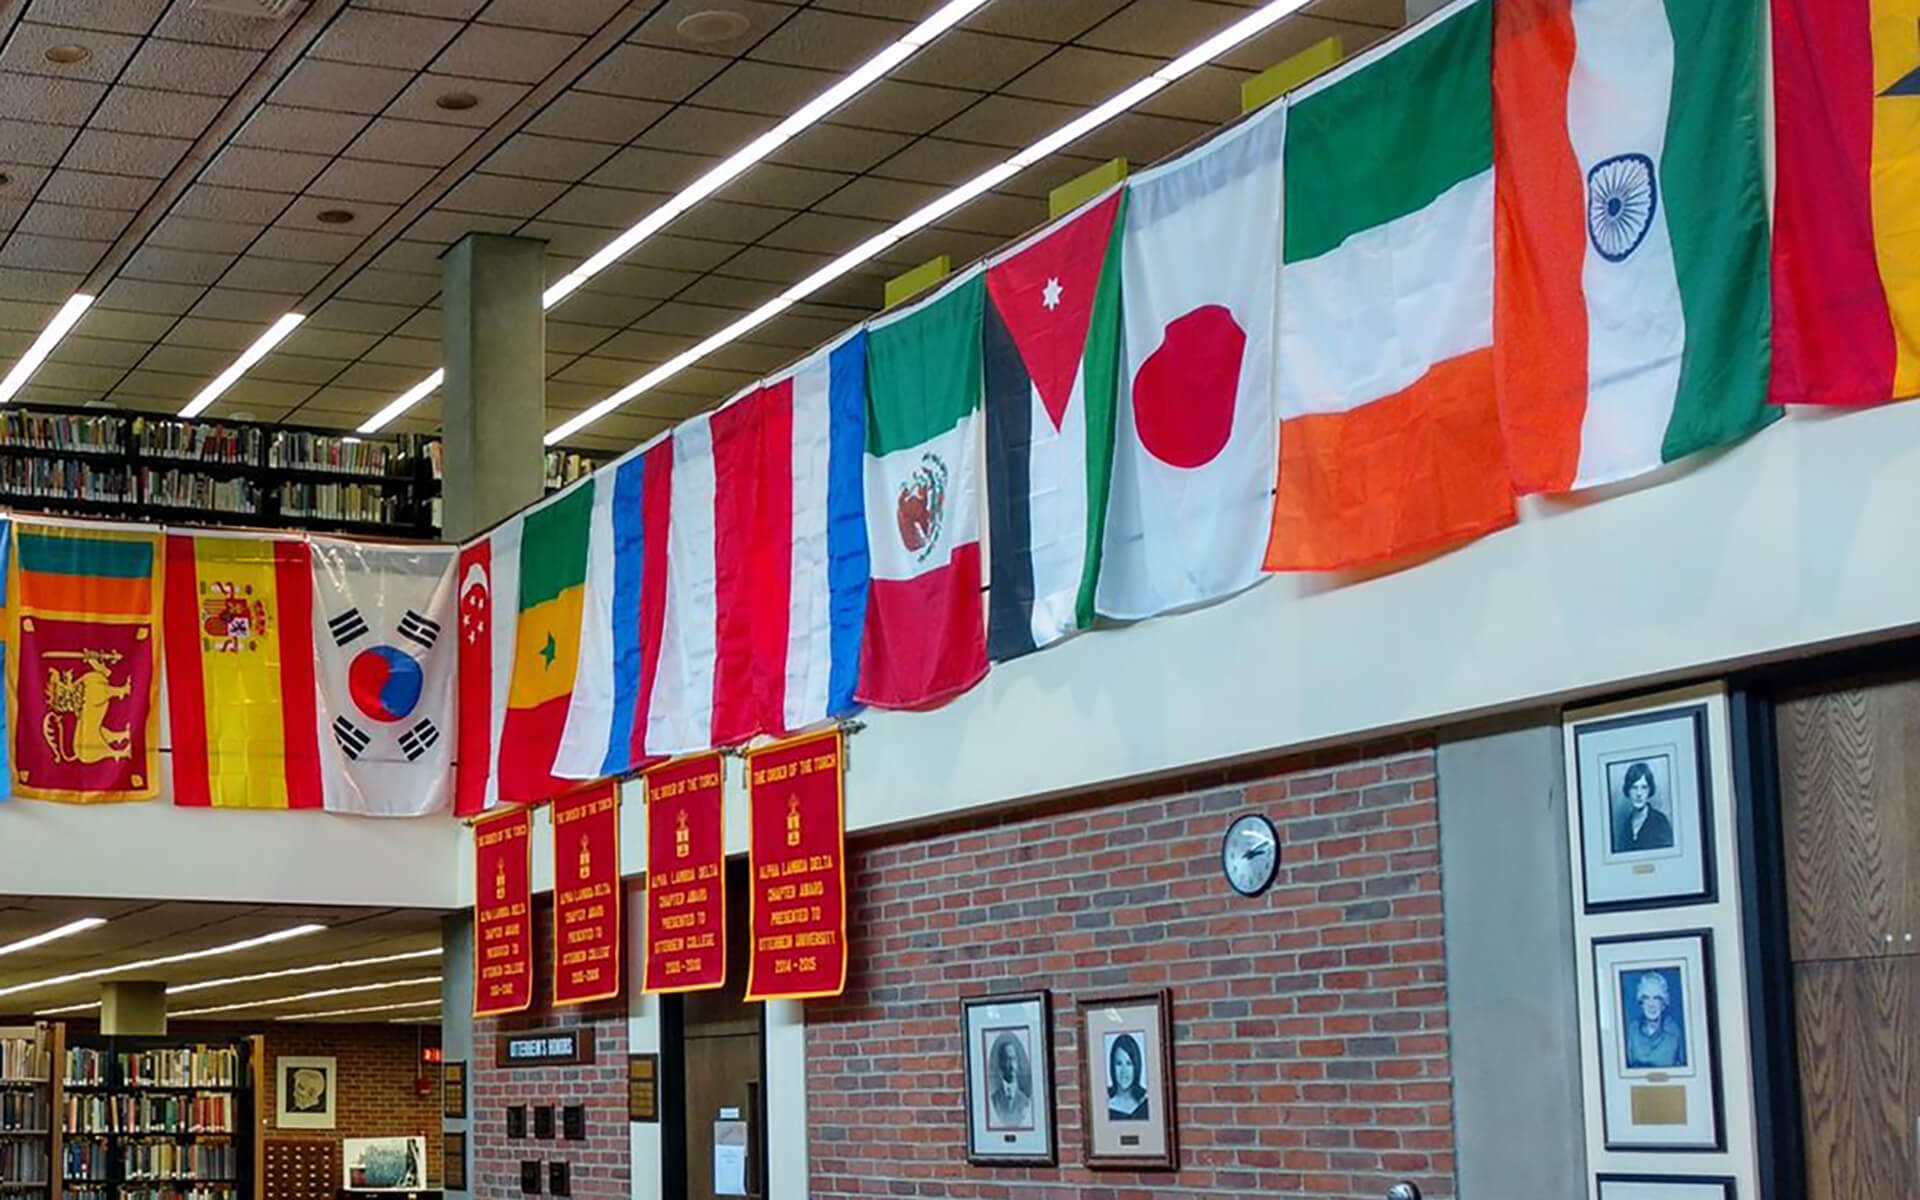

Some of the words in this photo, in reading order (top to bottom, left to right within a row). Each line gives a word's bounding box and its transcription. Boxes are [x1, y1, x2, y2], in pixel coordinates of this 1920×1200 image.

[754, 769, 766, 785] THE
[800, 758, 812, 775] THE
[813, 753, 836, 772] TORCH
[809, 855, 833, 872] DELTA
[768, 884, 796, 902] CHAPTER
[810, 906, 821, 921] TO
